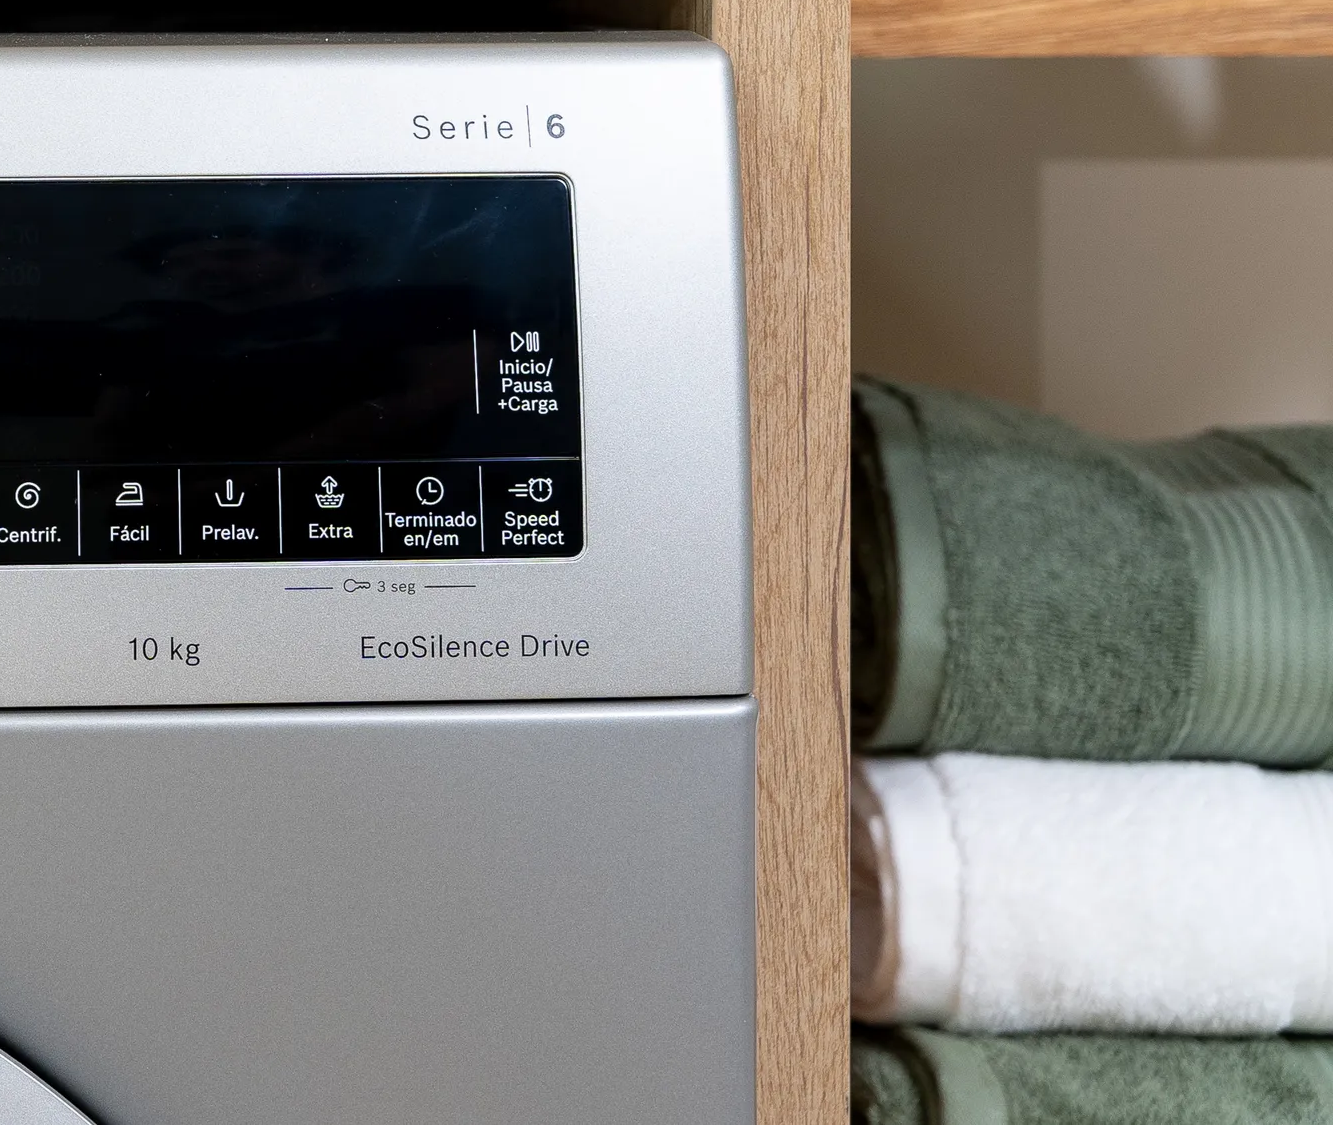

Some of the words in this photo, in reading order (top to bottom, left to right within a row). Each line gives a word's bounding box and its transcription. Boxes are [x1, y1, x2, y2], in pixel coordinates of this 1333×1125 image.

[412, 114, 513, 140] Serie
[546, 113, 566, 139] 6
[499, 358, 553, 377] Inicio/
[501, 378, 553, 393] Pausa
[498, 395, 558, 415] +Carga
[385, 511, 477, 528] Terminado
[504, 510, 559, 529] Speed
[109, 525, 150, 542] Fácil
[202, 524, 259, 541] Prelav.
[308, 523, 353, 540] Extra
[404, 530, 459, 549] en/em
[501, 529, 564, 546] Perfect
[377, 580, 386, 593] 3
[391, 582, 416, 595] seg
[129, 637, 158, 661] 10
[170, 637, 201, 666] kg
[360, 635, 510, 660] EcoSilence
[520, 633, 590, 658] Drive
